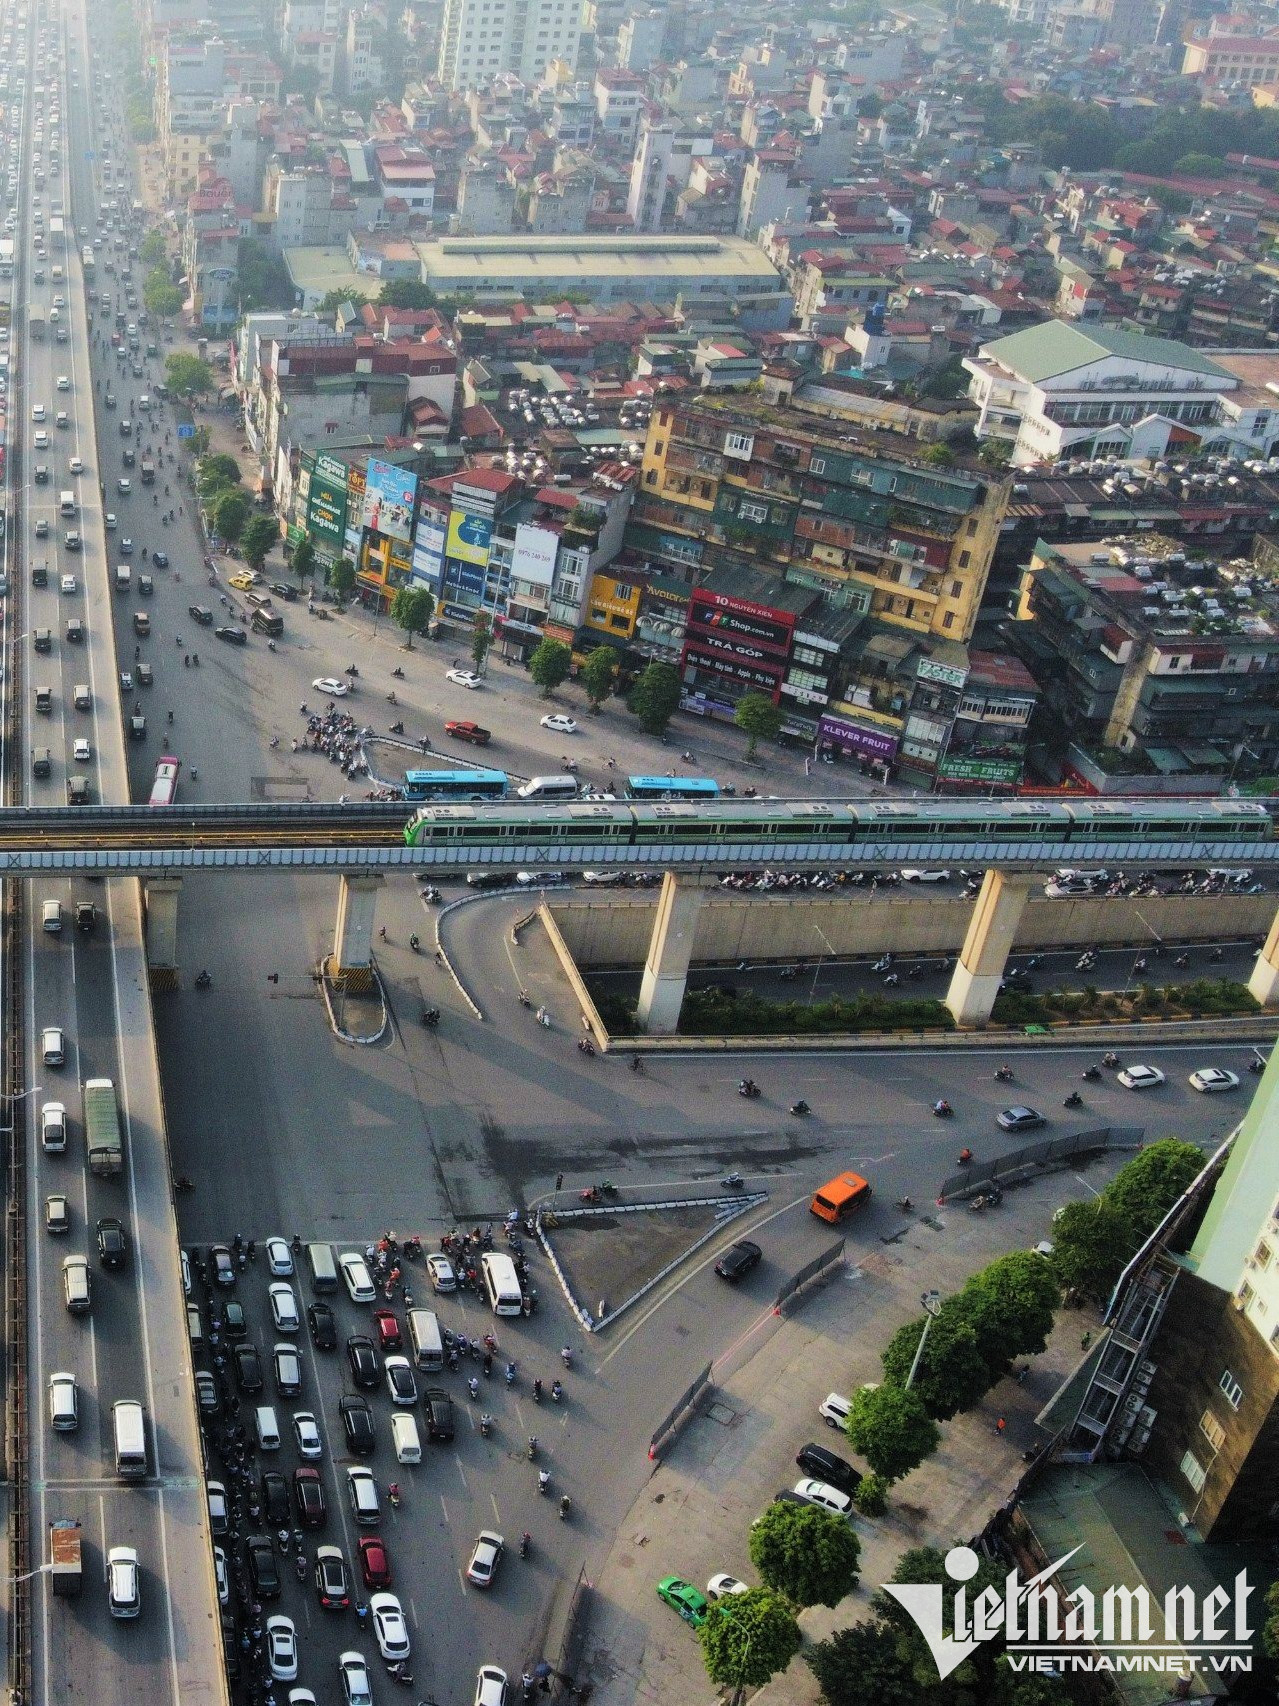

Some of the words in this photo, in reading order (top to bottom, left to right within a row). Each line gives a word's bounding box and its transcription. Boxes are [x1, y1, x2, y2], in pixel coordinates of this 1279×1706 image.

[310, 511, 339, 533] Kagawa
[715, 596, 728, 606] 10
[730, 619, 774, 638] Shop.com.vn
[824, 724, 860, 741] KLEVER
[862, 736, 890, 750] FRUIT
[942, 764, 972, 773] FRESH
[981, 767, 1015, 776] FRUITS
